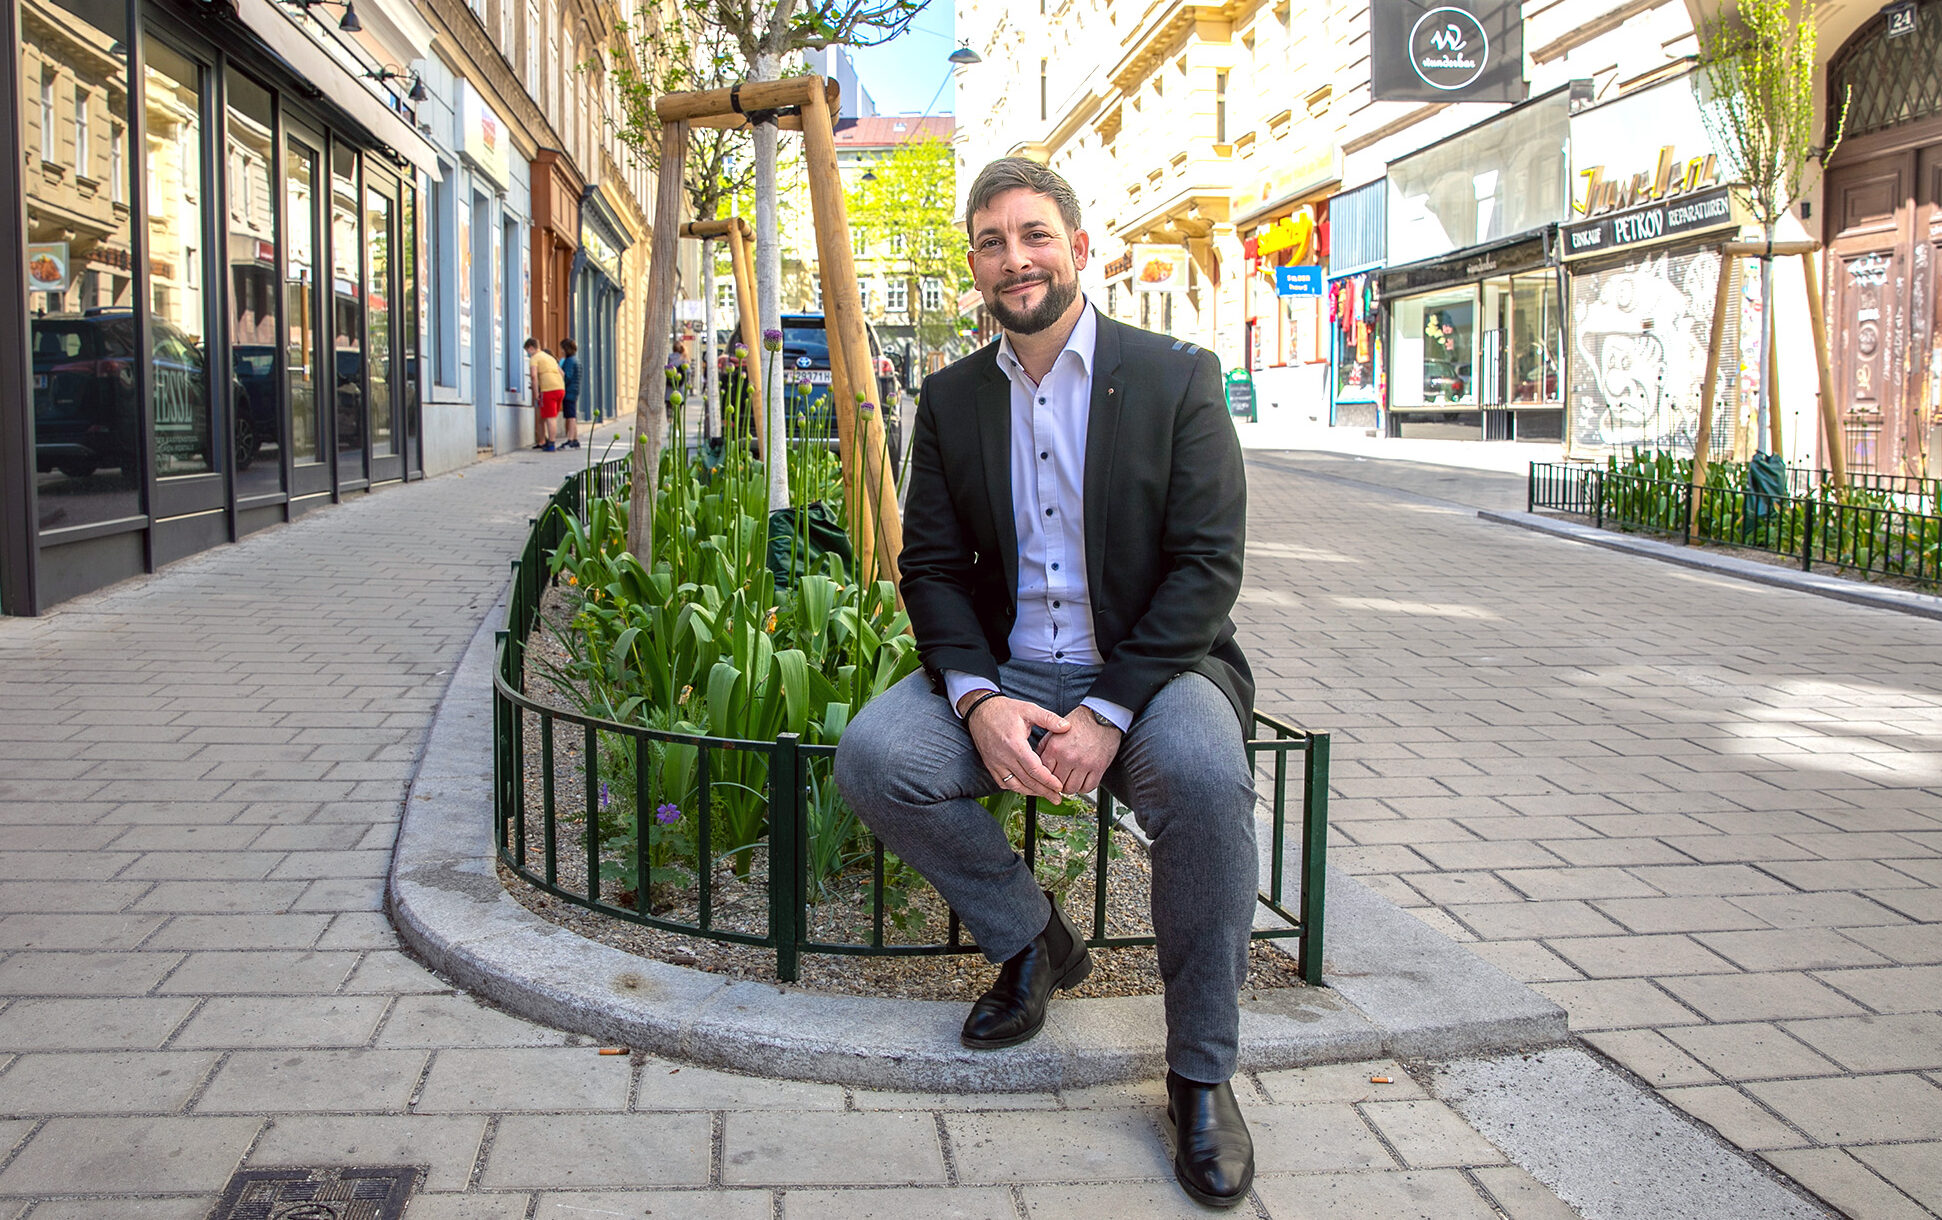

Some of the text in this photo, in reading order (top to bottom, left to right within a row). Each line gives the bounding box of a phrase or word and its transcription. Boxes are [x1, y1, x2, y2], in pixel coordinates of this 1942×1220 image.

[1893, 9, 1912, 28] 24
[1614, 208, 1664, 244] PETKOV
[1668, 196, 1729, 227] REPARATUREN
